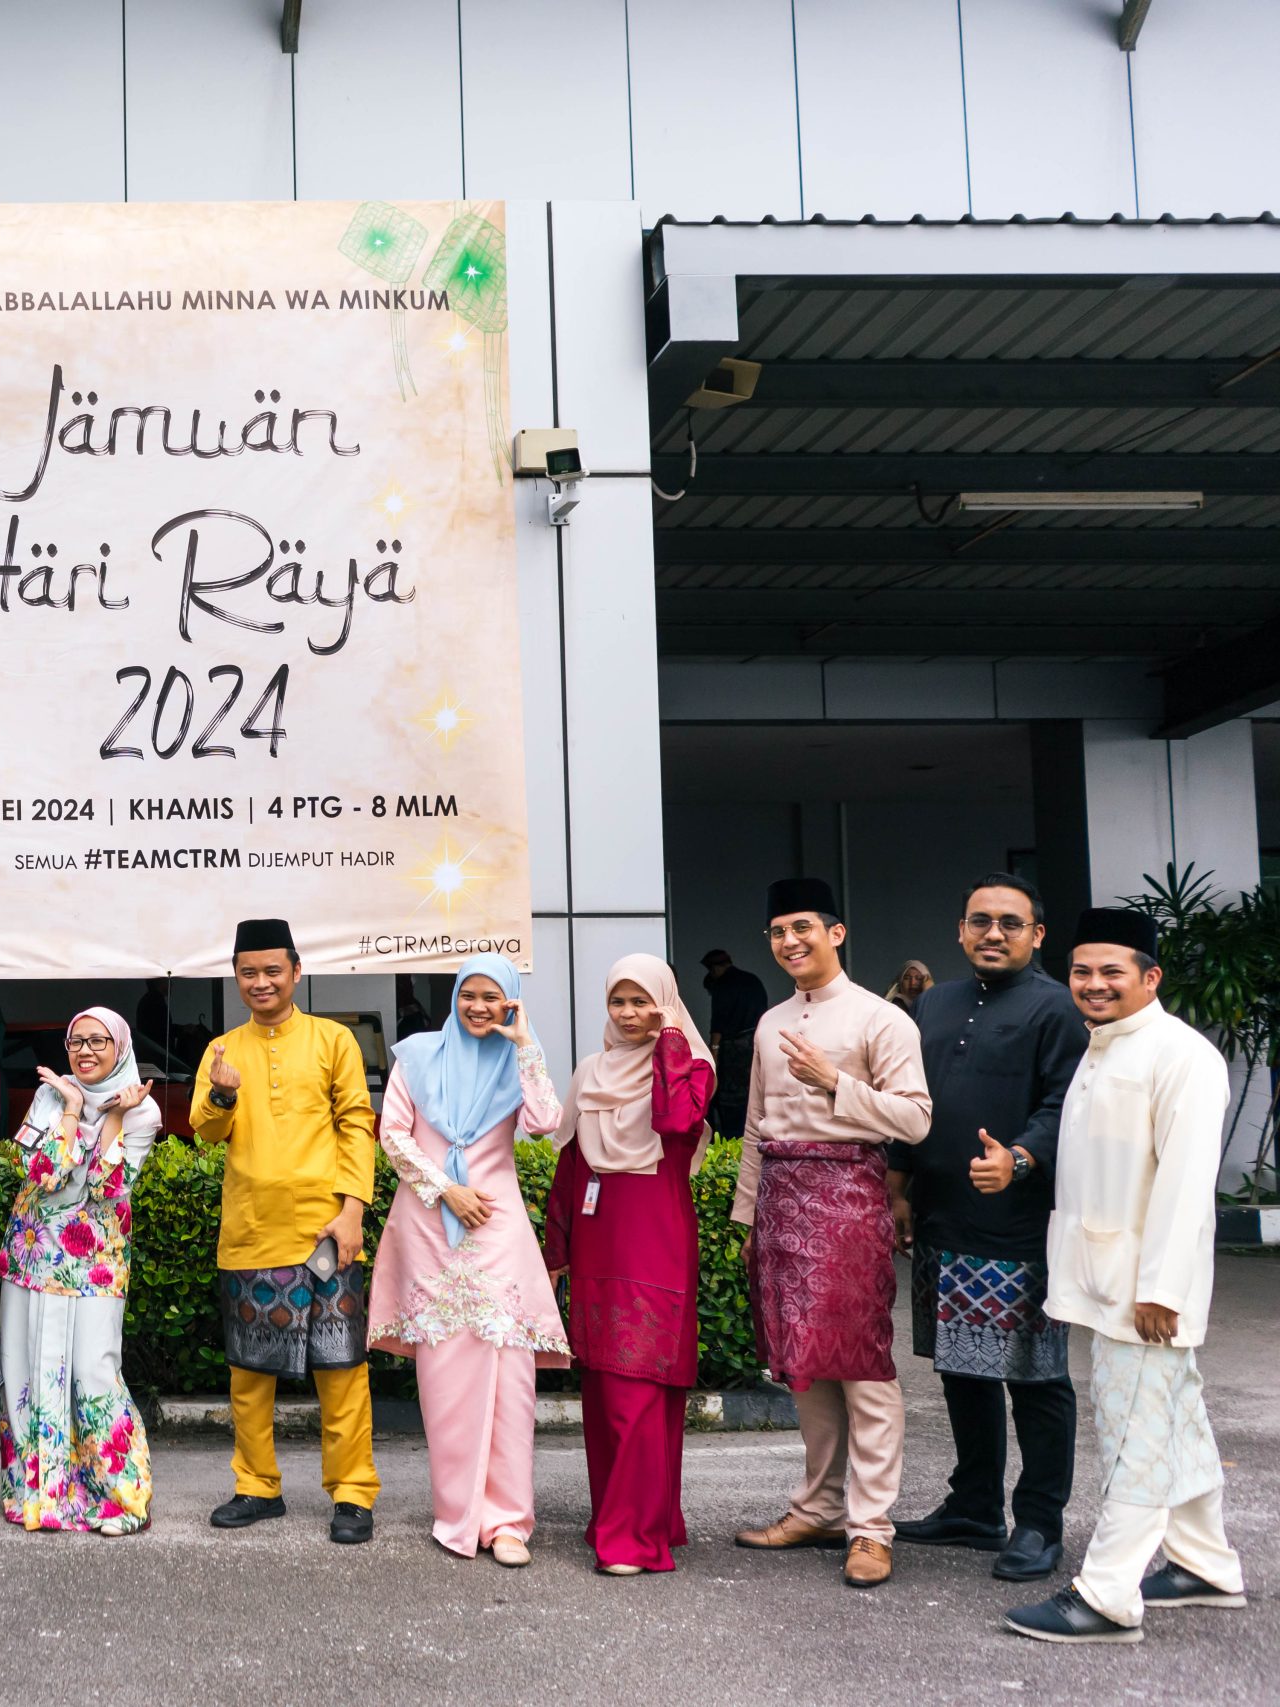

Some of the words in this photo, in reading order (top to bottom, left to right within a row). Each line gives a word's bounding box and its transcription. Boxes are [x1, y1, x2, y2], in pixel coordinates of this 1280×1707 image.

[181, 290, 277, 310] MINNA
[284, 289, 330, 310] WA
[339, 289, 450, 311] MINKUM
[99, 663, 290, 761] 2024
[31, 798, 95, 822] 2024
[129, 797, 234, 821] KHAMIS
[267, 796, 284, 819] 4
[293, 795, 343, 819] PTG
[371, 795, 387, 818] 8
[395, 794, 459, 817] MLM
[14, 854, 78, 870] SEMUA
[84, 848, 241, 870] #TEAMCTRM
[248, 851, 334, 868] DIJEMPUT
[341, 851, 395, 867] HADIR
[359, 935, 521, 955] #CTRMBeraya
